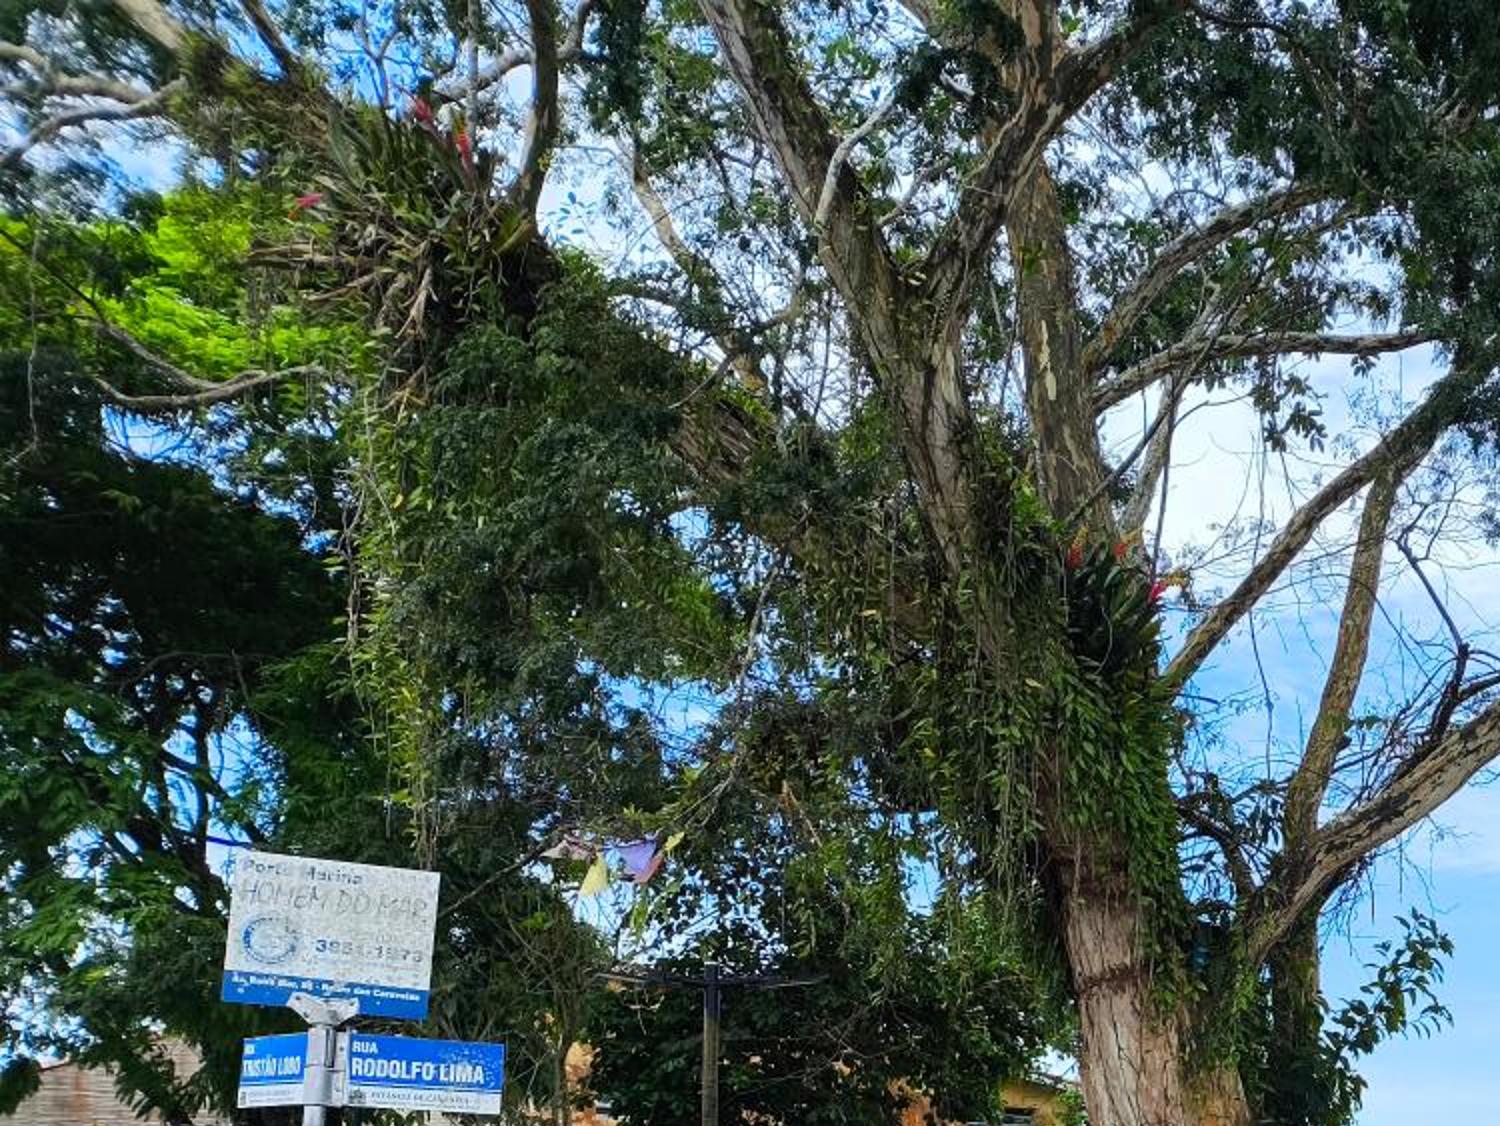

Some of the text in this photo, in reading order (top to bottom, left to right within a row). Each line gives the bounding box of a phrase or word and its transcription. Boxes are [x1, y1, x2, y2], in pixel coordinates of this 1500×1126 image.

[352, 1040, 378, 1054] RUA
[351, 1057, 485, 1084] RODOLFO LIMA
